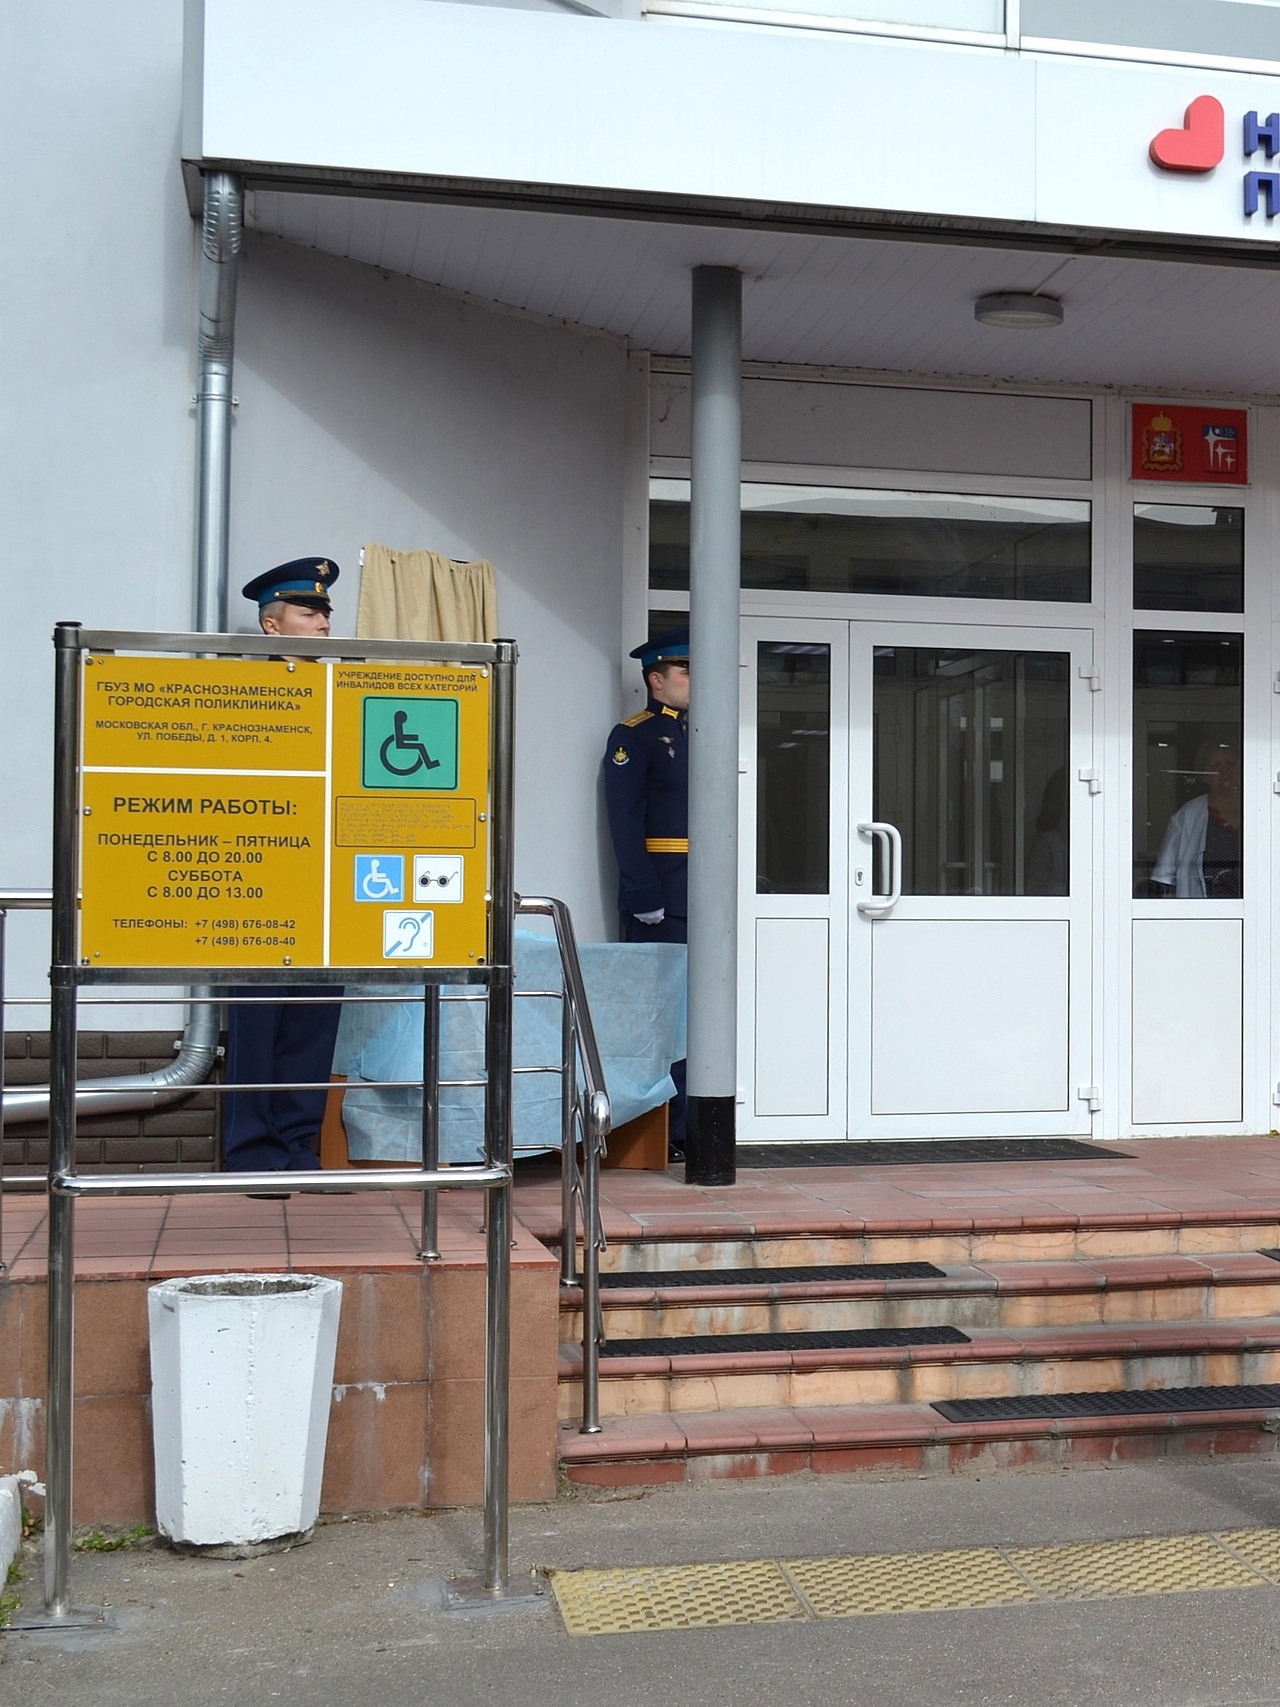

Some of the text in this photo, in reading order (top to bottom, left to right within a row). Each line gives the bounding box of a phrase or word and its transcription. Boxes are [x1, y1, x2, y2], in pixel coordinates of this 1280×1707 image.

[338, 671, 476, 683] УЧРЕЖДЕНИЕ ДОСТУПНО ДЛЯ
[97, 681, 312, 698] ГБУЗ МО «КРАСНОЗНАМЕНСКАЯ
[336, 681, 394, 690] ИНВАЛИДОВ
[424, 683, 477, 692] КАТЕГОРИЙ
[108, 695, 301, 711] ГОРОДСКАЯ ПОЛИКЛИНИКА»
[96, 721, 168, 730] МОСКОВСКАЯ
[202, 722, 210, 731] Г.
[213, 723, 312, 735] КРАСНОЗНАМЕНСК,
[137, 732, 152, 741] УЛ.
[156, 732, 204, 742] ПОБЕДЫ,
[207, 733, 218, 743] Д.
[221, 733, 228, 743] 1,
[232, 734, 261, 743] КОРП.
[113, 797, 297, 815] РЕЖИМ РАБОТЫ:
[98, 834, 218, 847] ПОНЕДЕЛЬНИК
[236, 836, 311, 848] ПЯТНИЦА
[147, 851, 262, 865] С 8.00 ДО 20.00
[168, 870, 243, 882] СУББОТА
[147, 886, 263, 900] С 8.00 ДО 13.00
[113, 919, 295, 930] ТЕЛЕФОНЫ: +7 (498) 676-08-42
[195, 936, 295, 947] +7 (498) 676-08-40
